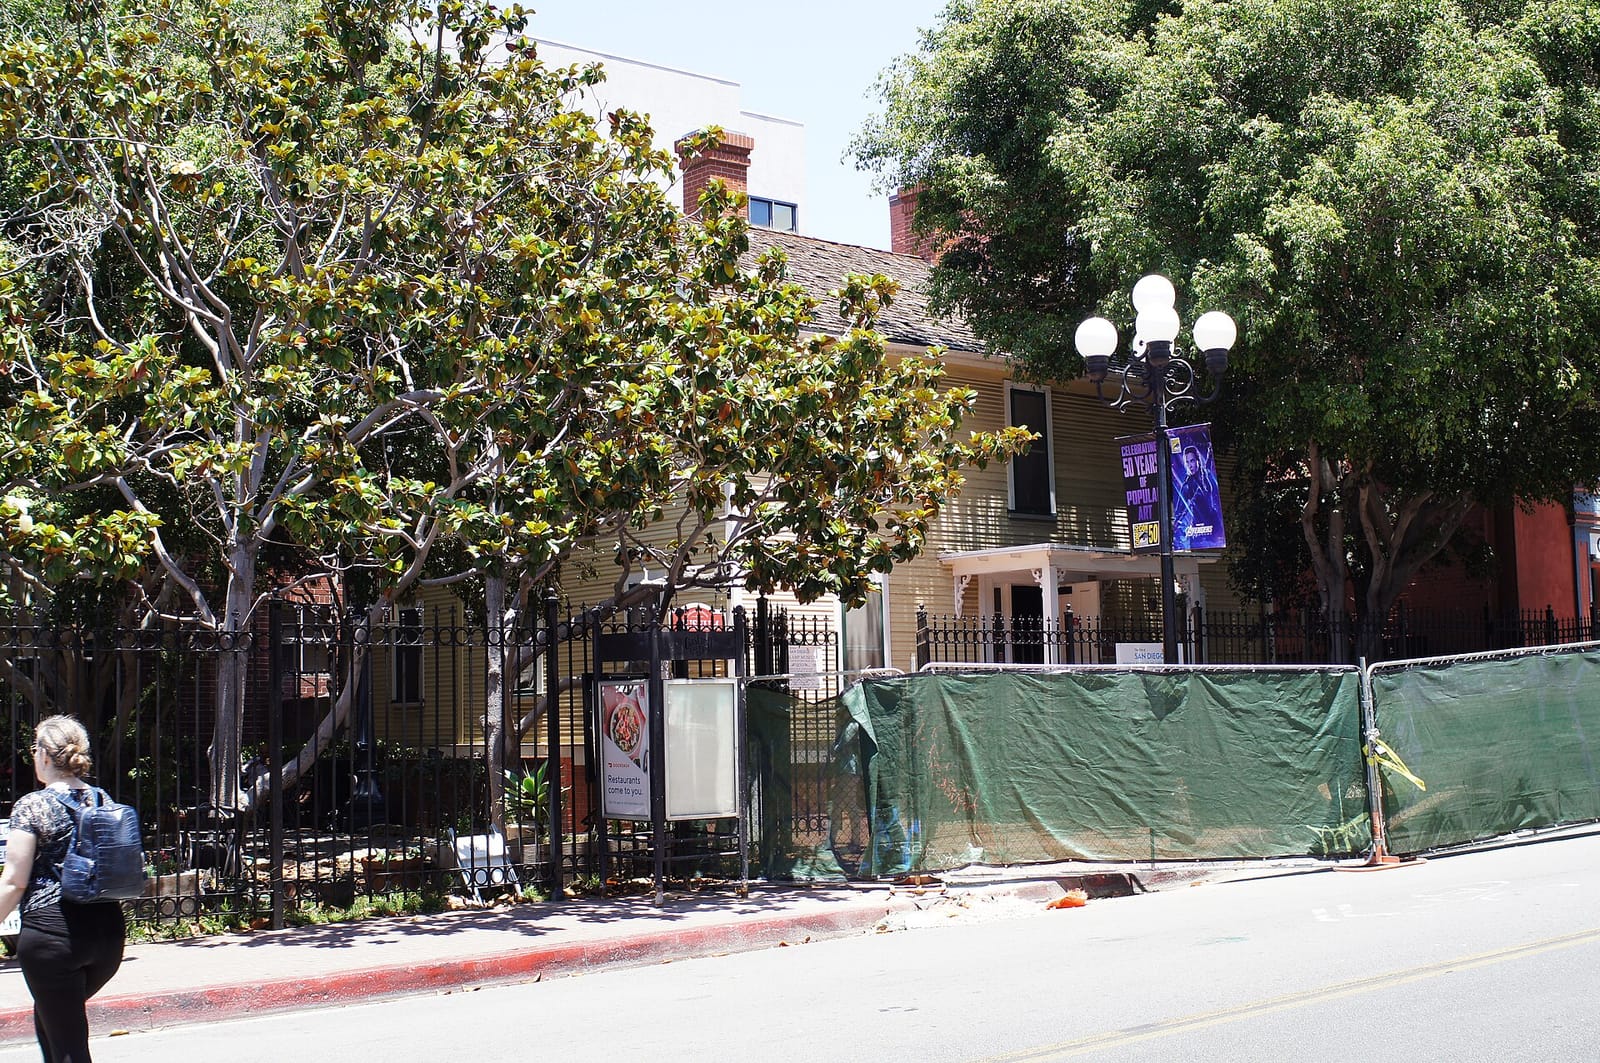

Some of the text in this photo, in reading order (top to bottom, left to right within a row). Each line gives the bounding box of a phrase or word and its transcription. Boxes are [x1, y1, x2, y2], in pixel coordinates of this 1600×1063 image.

[1123, 457, 1134, 477] 50
[1139, 475, 1147, 488] OF
[1126, 487, 1158, 505] POPULA
[1138, 504, 1153, 521] ART
[1148, 523, 1158, 544] 50
[608, 774, 641, 785] Restaurants
[624, 786, 631, 794] to
